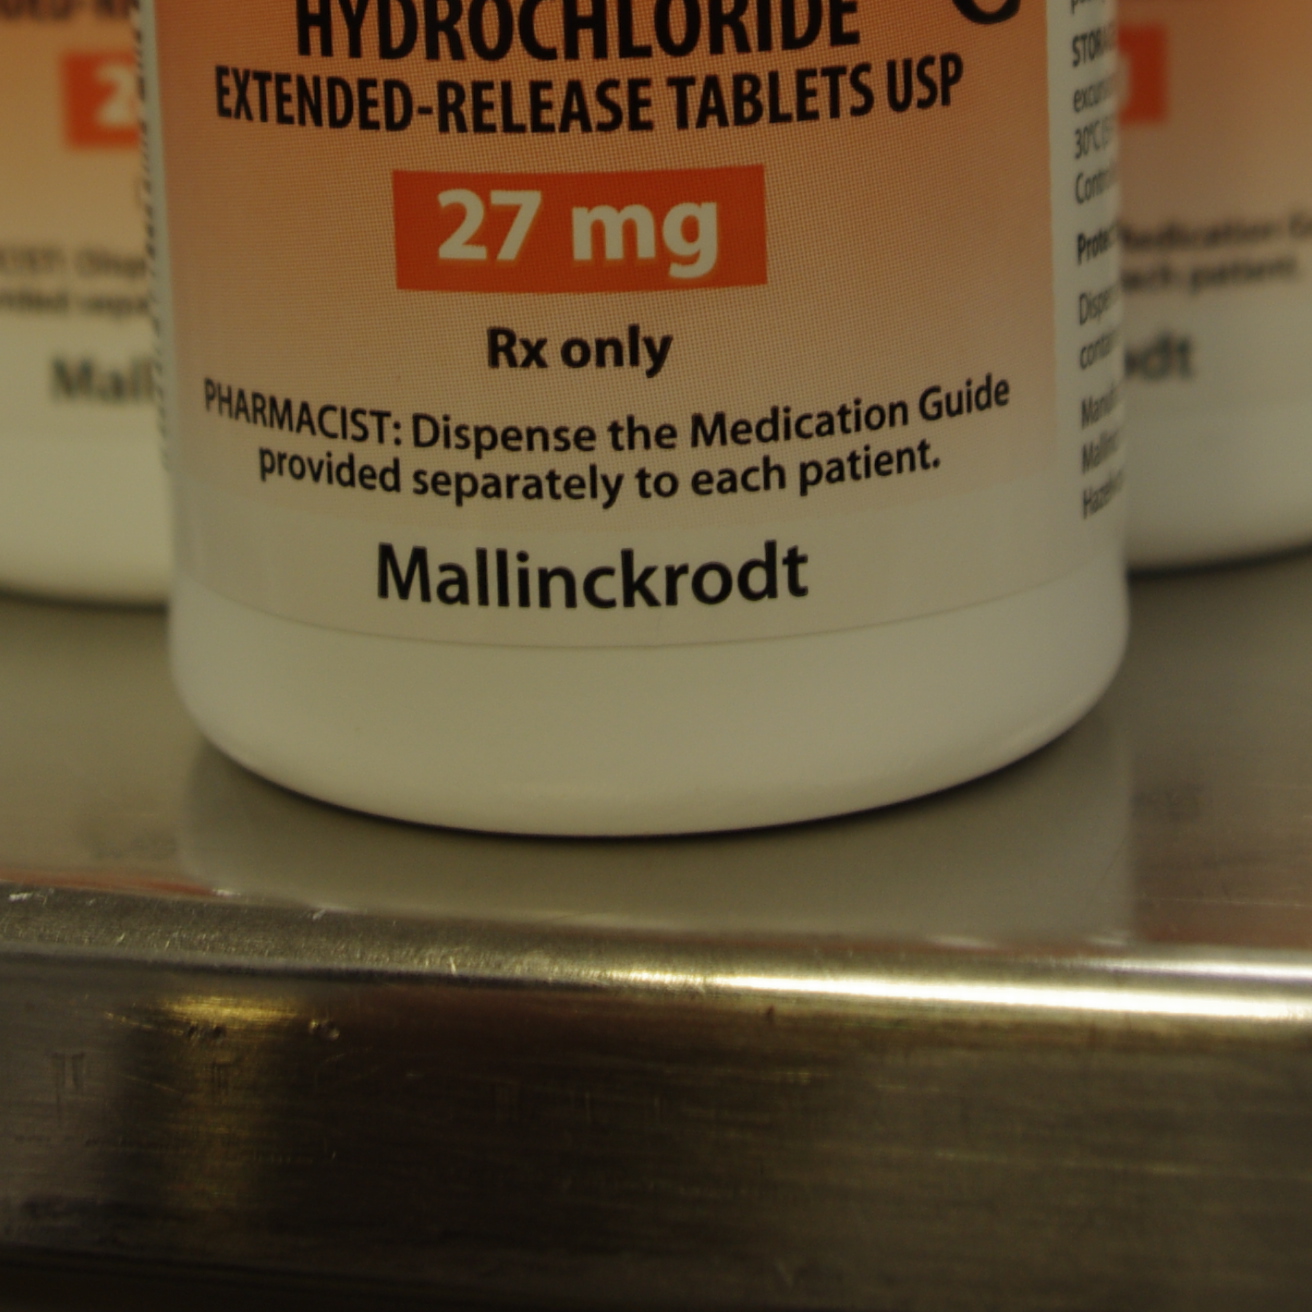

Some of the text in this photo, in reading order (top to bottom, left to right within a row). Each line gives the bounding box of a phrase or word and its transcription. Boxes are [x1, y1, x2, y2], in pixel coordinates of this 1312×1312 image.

[214, 51, 964, 135] EXTENDED-RELEASE TABLETS USP
[436, 188, 720, 280] 27 mg
[488, 324, 674, 377] Rx only
[203, 373, 1011, 459] PHARMACIST: Dispense the Medication Guide
[258, 438, 941, 508] provided separately to each patient.
[376, 539, 810, 609] Mallinckrodt
